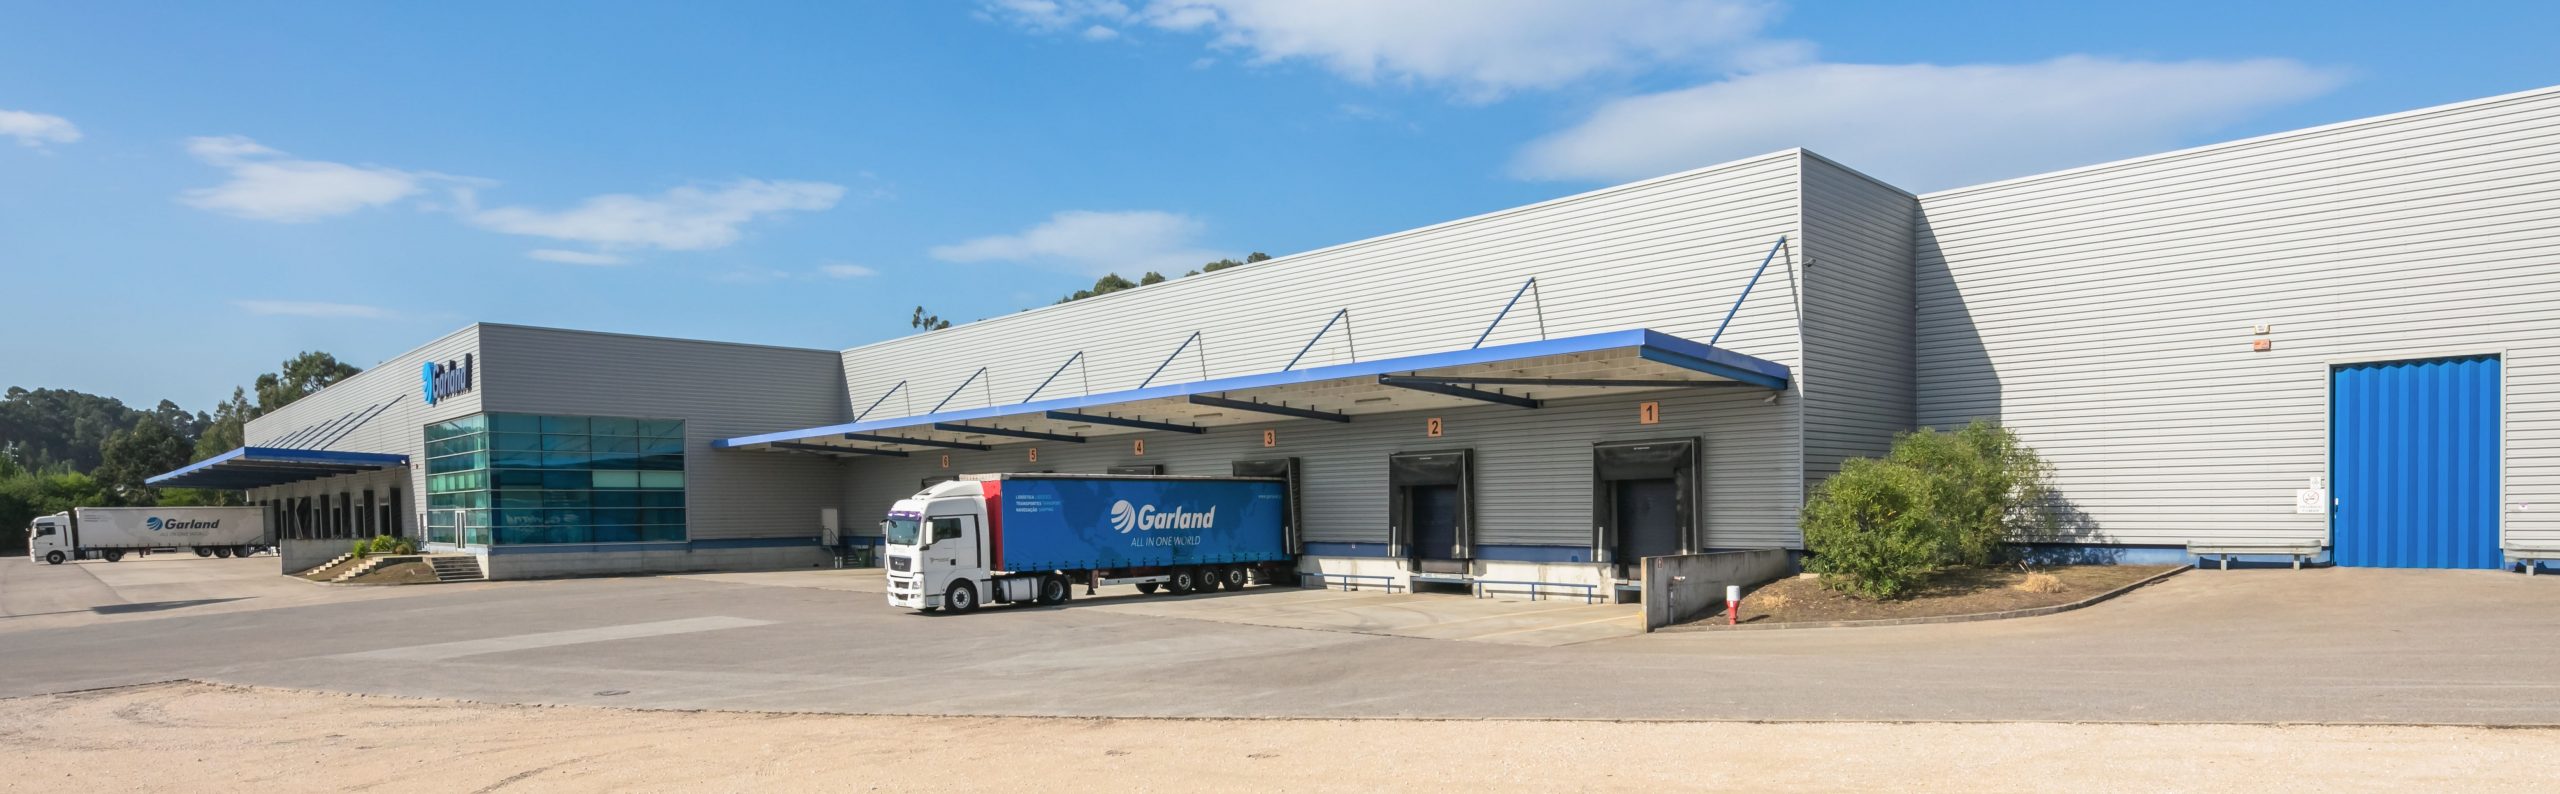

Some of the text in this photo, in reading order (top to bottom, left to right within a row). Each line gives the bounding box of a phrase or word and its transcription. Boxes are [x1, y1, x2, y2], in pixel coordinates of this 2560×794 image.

[433, 353, 472, 399] Garland
[1646, 405, 1653, 421] 1
[1431, 420, 1439, 435] 2
[1267, 431, 1273, 445] 3
[165, 518, 221, 530] Garland
[1138, 504, 1216, 531] Garland
[1131, 535, 1201, 547] ALL IN ONE WORLD
